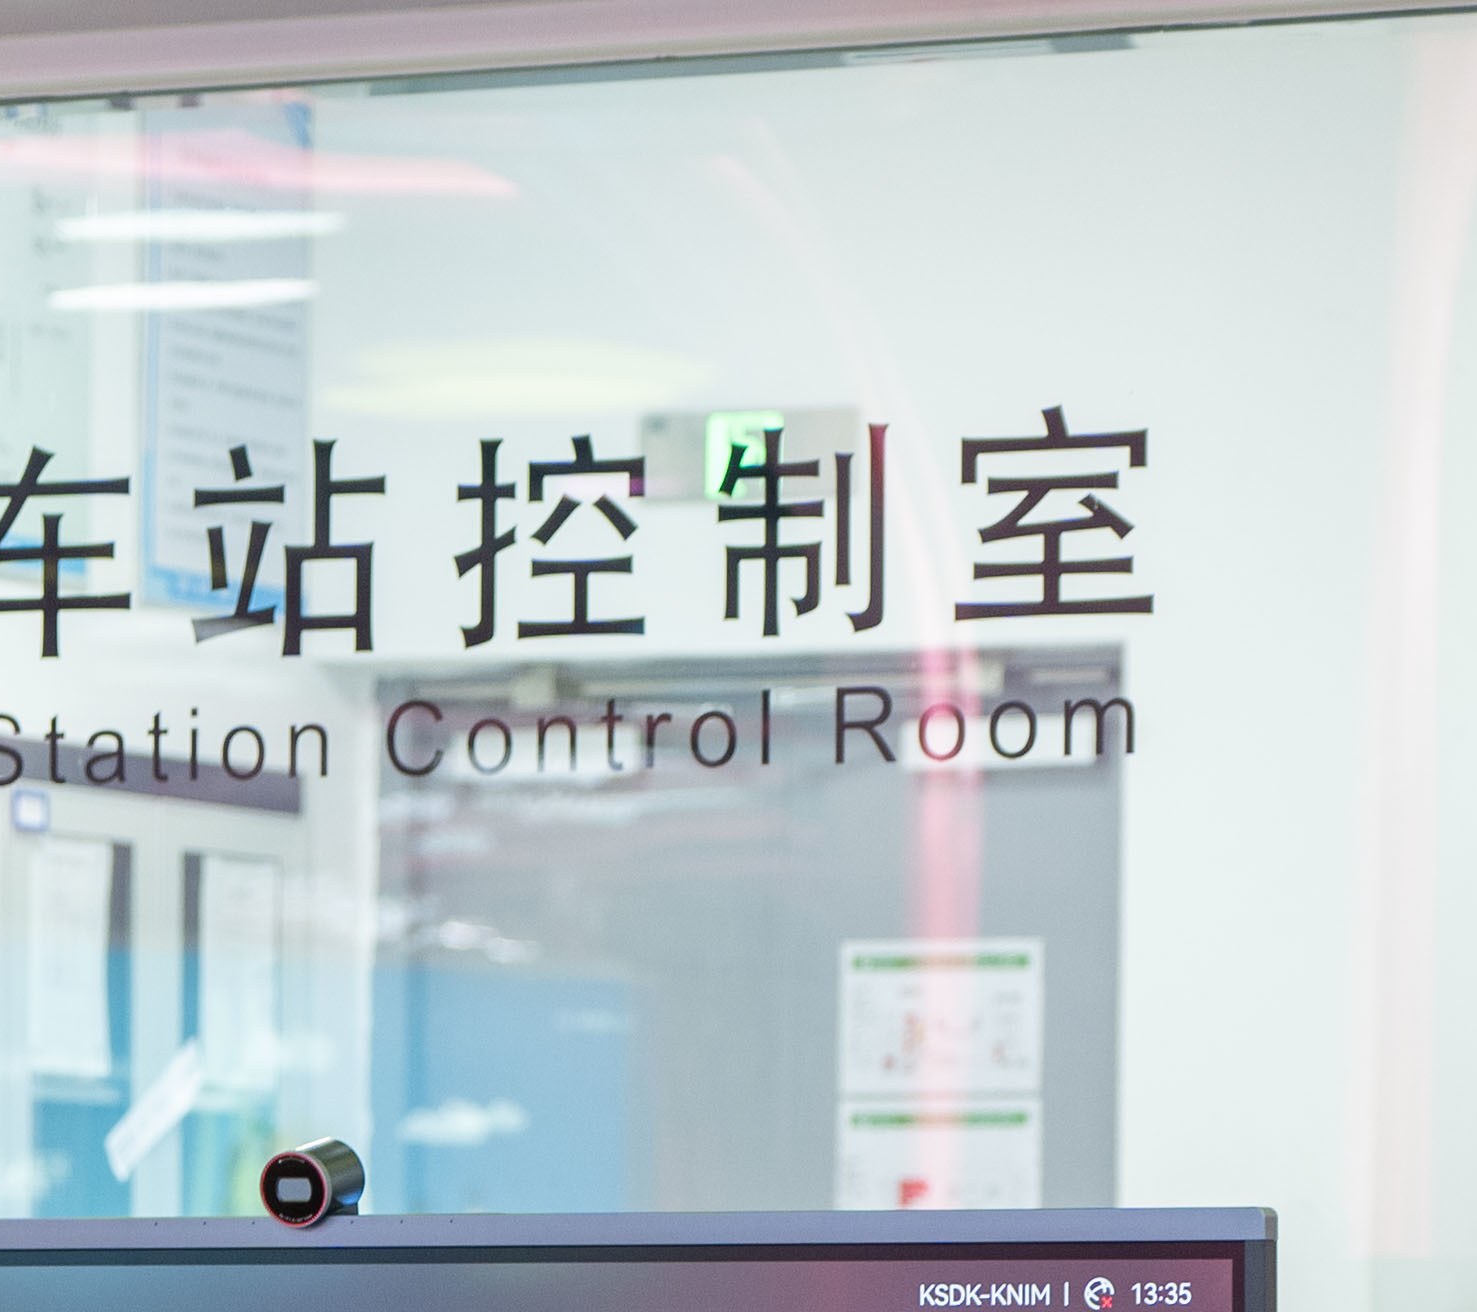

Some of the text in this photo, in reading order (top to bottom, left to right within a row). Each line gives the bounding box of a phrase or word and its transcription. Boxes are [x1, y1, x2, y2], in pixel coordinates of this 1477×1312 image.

[385, 688, 773, 777] Control
[834, 684, 1137, 764] Room
[919, 1282, 1192, 1307] KSDK-KNIM 13:35
